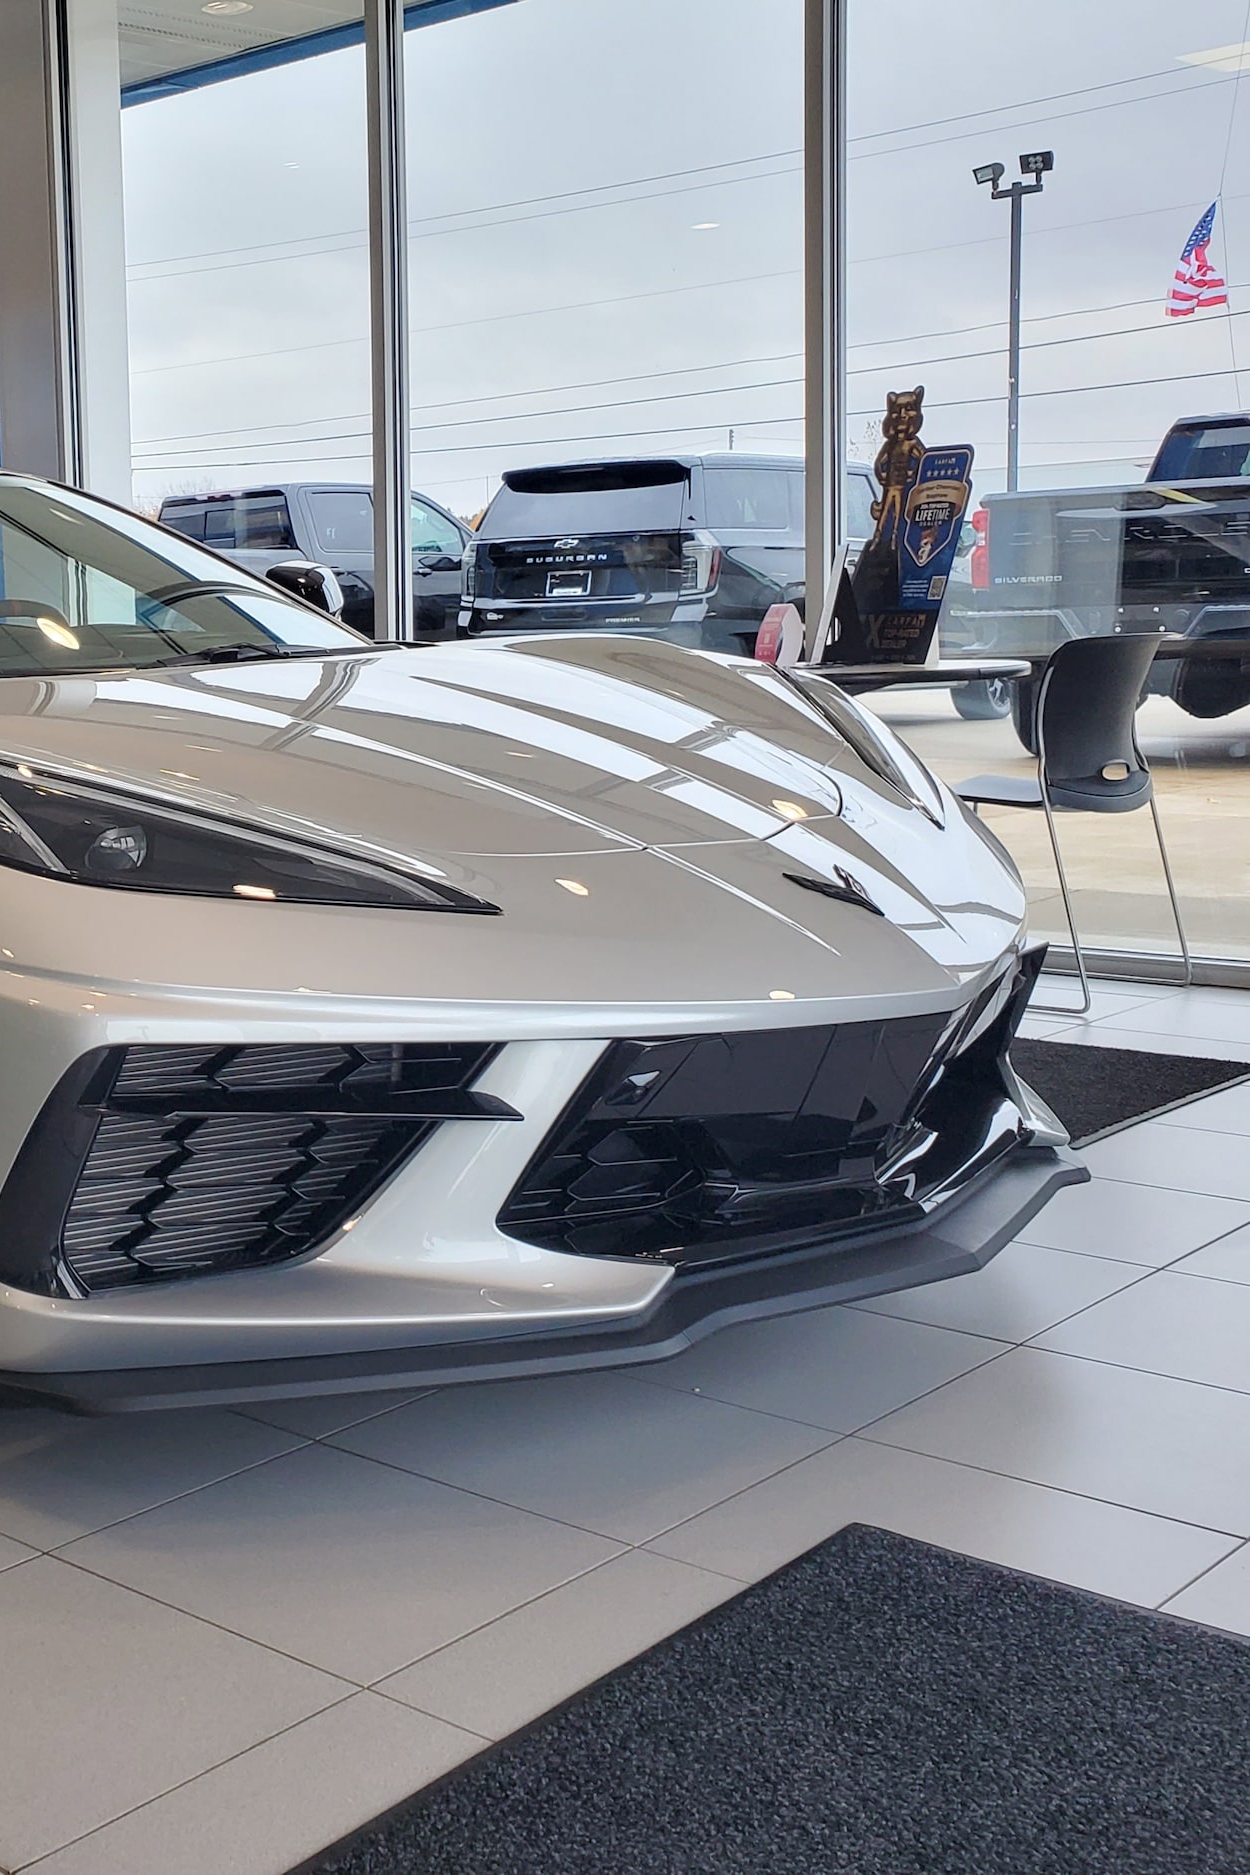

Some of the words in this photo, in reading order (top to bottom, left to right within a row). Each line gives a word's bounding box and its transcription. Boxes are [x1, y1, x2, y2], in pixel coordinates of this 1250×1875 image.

[915, 507, 951, 522] LIFETIME
[526, 553, 608, 564] SUBURBAN
[994, 575, 1063, 584] SILVERADO
